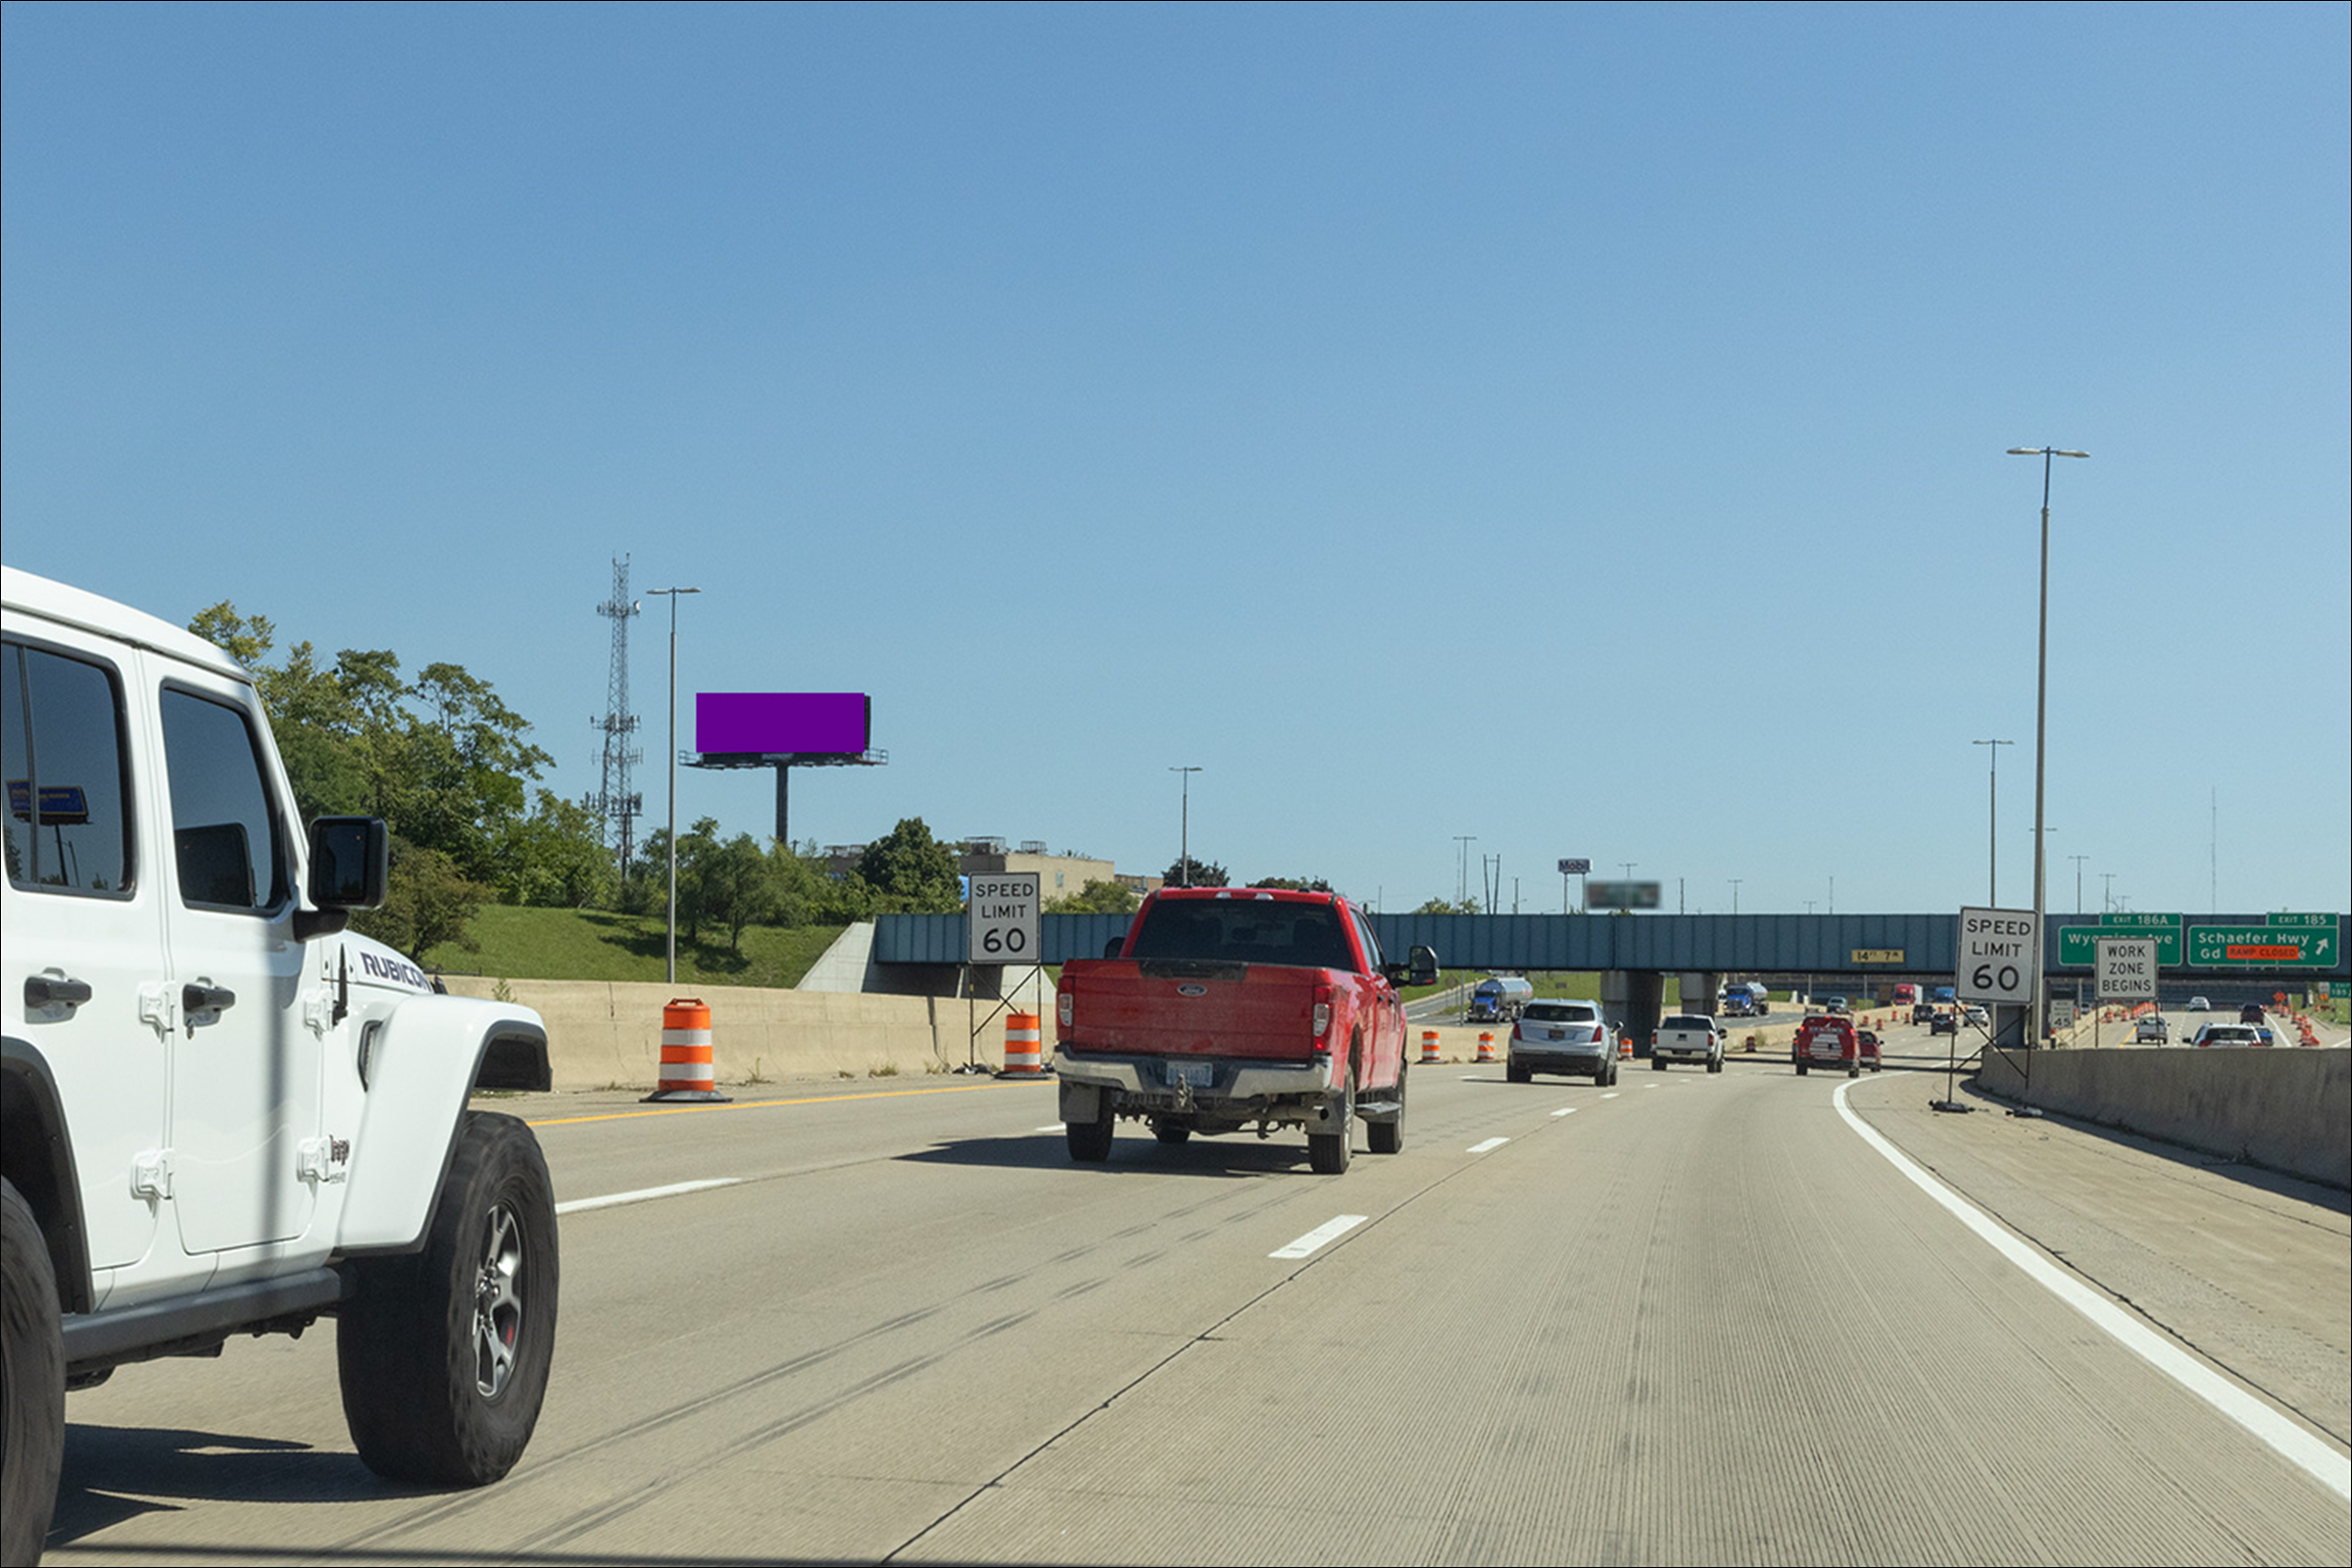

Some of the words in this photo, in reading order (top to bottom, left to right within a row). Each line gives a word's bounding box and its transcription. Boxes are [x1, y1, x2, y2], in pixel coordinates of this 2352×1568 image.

[1559, 859, 1590, 871] Mobil
[976, 884, 1033, 897] SPEED
[982, 905, 1026, 918] LIMIT
[2137, 915, 2168, 925] 186A
[2304, 914, 2327, 925] 185
[1967, 918, 2031, 936] SPEED
[983, 928, 1025, 953] 60
[2198, 932, 2268, 944] Schaefer
[2277, 933, 2309, 947] Hwy
[1972, 941, 2022, 957] LIMIT
[2107, 946, 2145, 957] WORK
[2200, 948, 2221, 959] Gd
[2259, 948, 2296, 957] CLOSED
[360, 952, 432, 992] RUBICON
[2109, 962, 2144, 975] ZONE
[1972, 964, 2020, 992] 60
[2102, 980, 2151, 992] BEGINS
